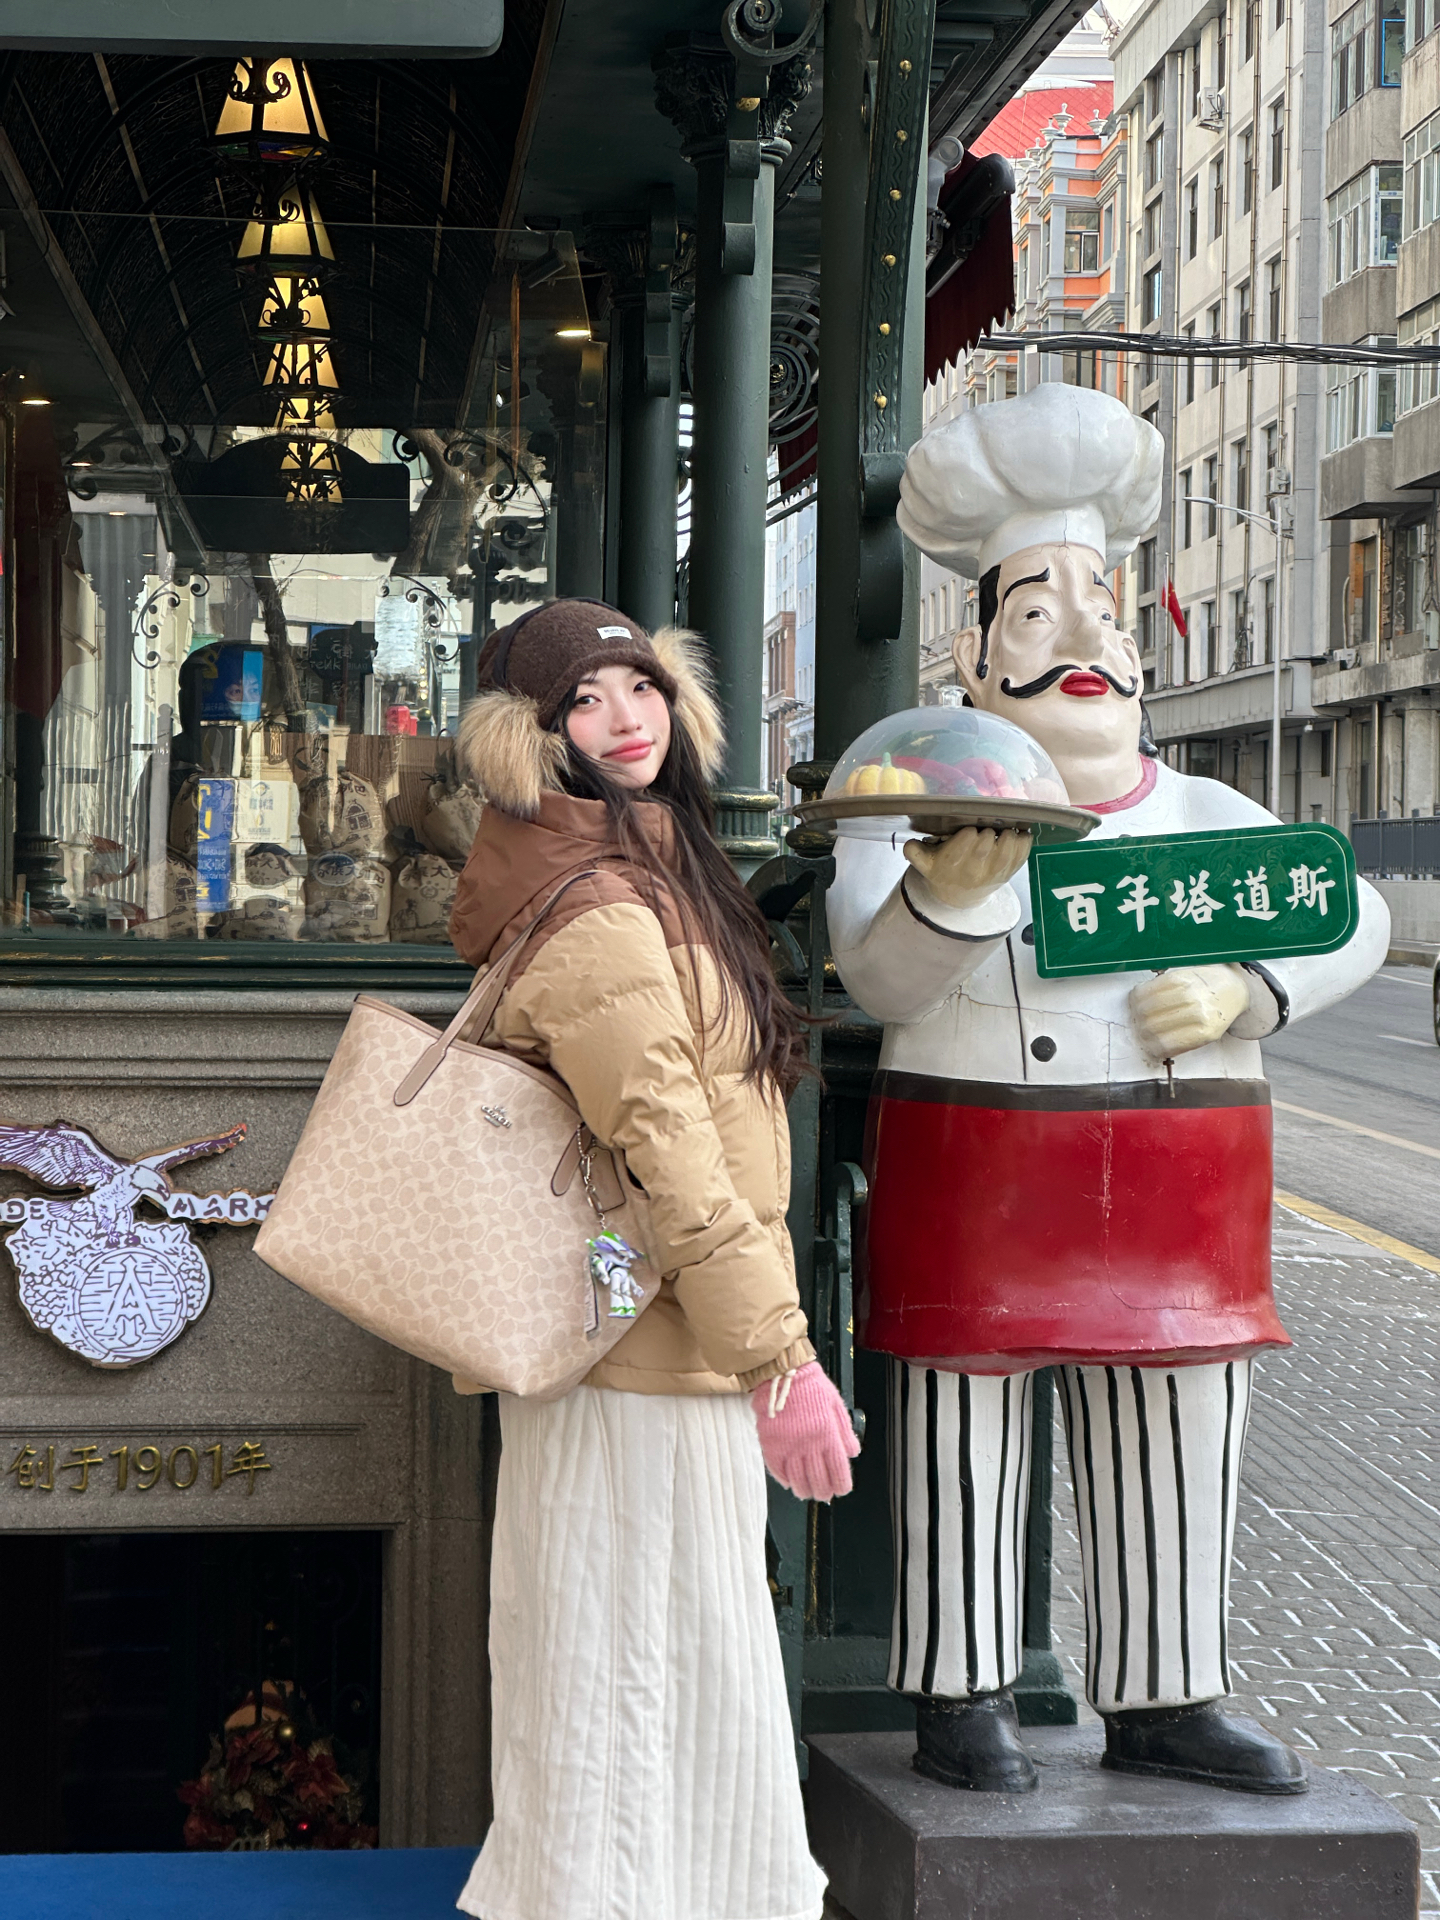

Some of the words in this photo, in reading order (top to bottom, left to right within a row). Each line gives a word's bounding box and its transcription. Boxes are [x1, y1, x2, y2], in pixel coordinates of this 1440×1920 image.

[1051, 863, 1336, 934] 百年塔道斯
[481, 1105, 512, 1129] COACH
[0, 1200, 44, 1220] DE
[6, 1442, 271, 1495] 创于1901年
